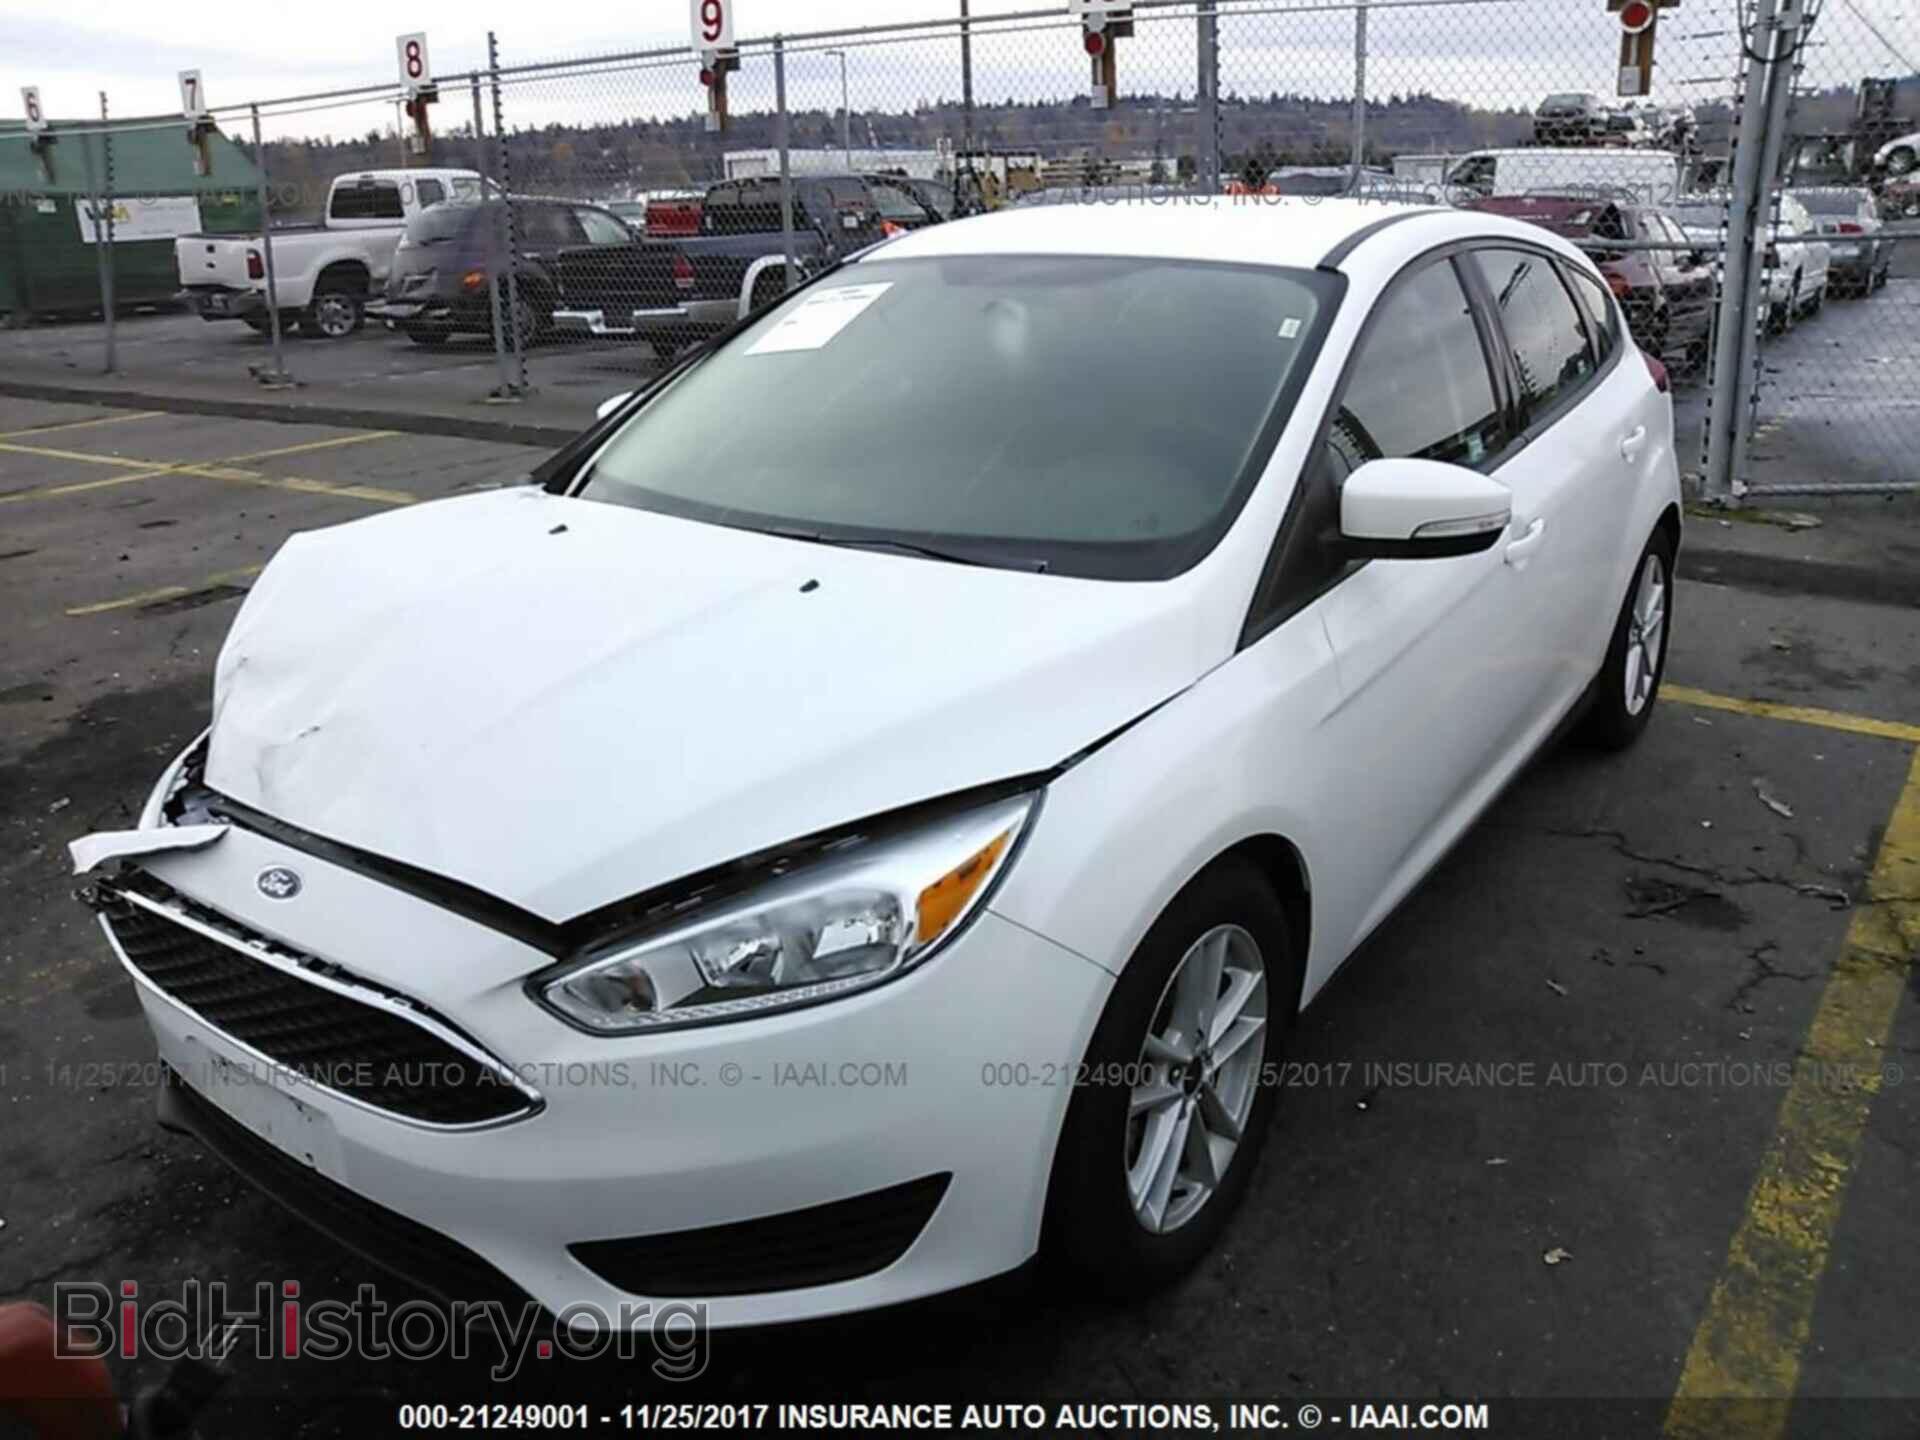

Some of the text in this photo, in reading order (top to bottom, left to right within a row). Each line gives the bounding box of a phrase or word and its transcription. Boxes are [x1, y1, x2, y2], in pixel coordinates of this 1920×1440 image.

[701, 0, 723, 42] 9
[406, 40, 422, 78] 8
[25, 92, 40, 122] 6
[184, 77, 197, 111] 7
